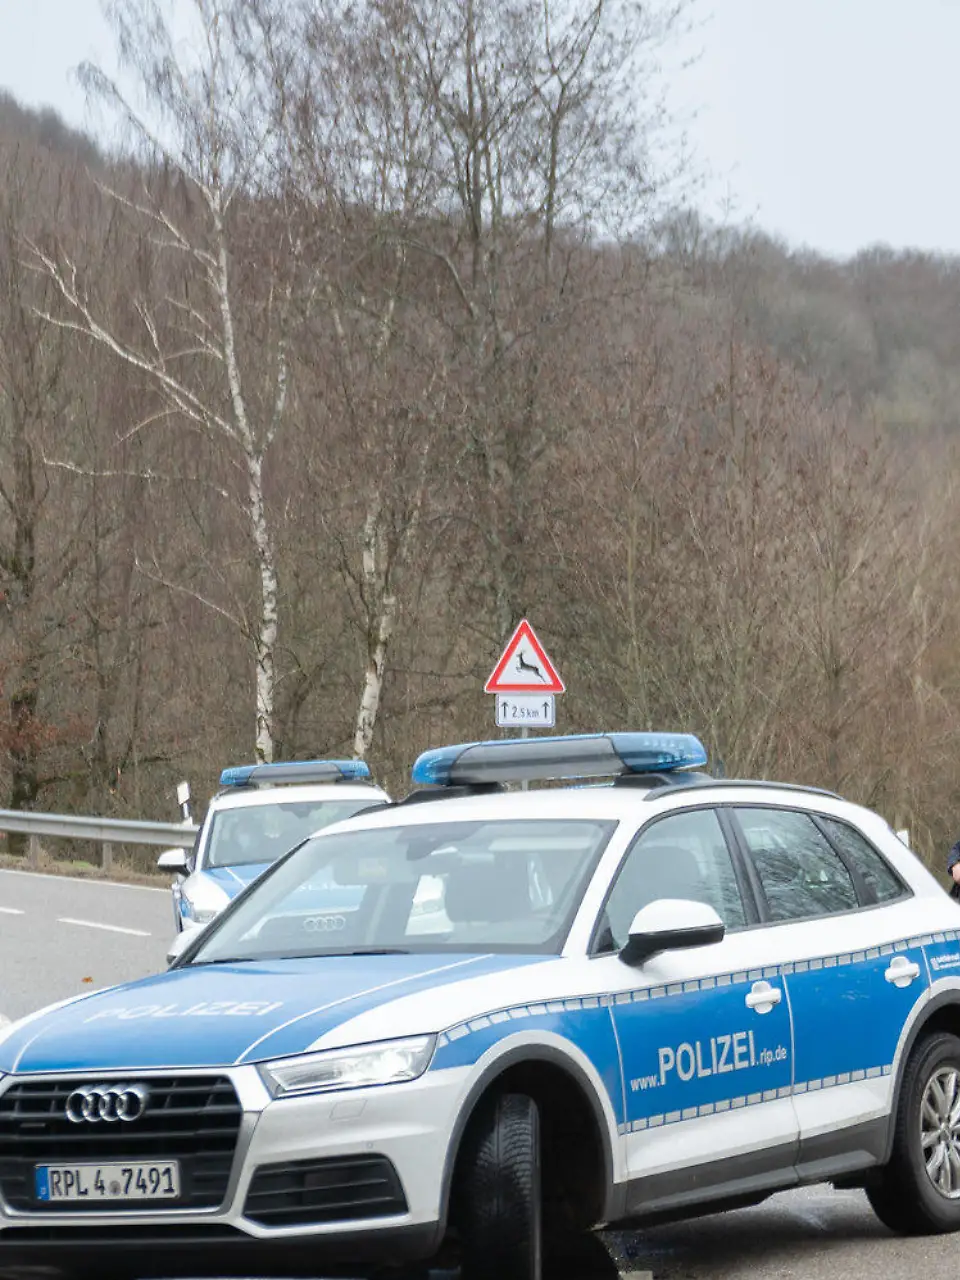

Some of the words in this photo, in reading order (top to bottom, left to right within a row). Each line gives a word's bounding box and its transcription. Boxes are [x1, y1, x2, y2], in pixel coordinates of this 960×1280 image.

[83, 1001, 284, 1024] POLIZEI
[49, 1169, 88, 1196] RPL
[94, 1168, 106, 1196] 4
[121, 1167, 175, 1195] 7491
